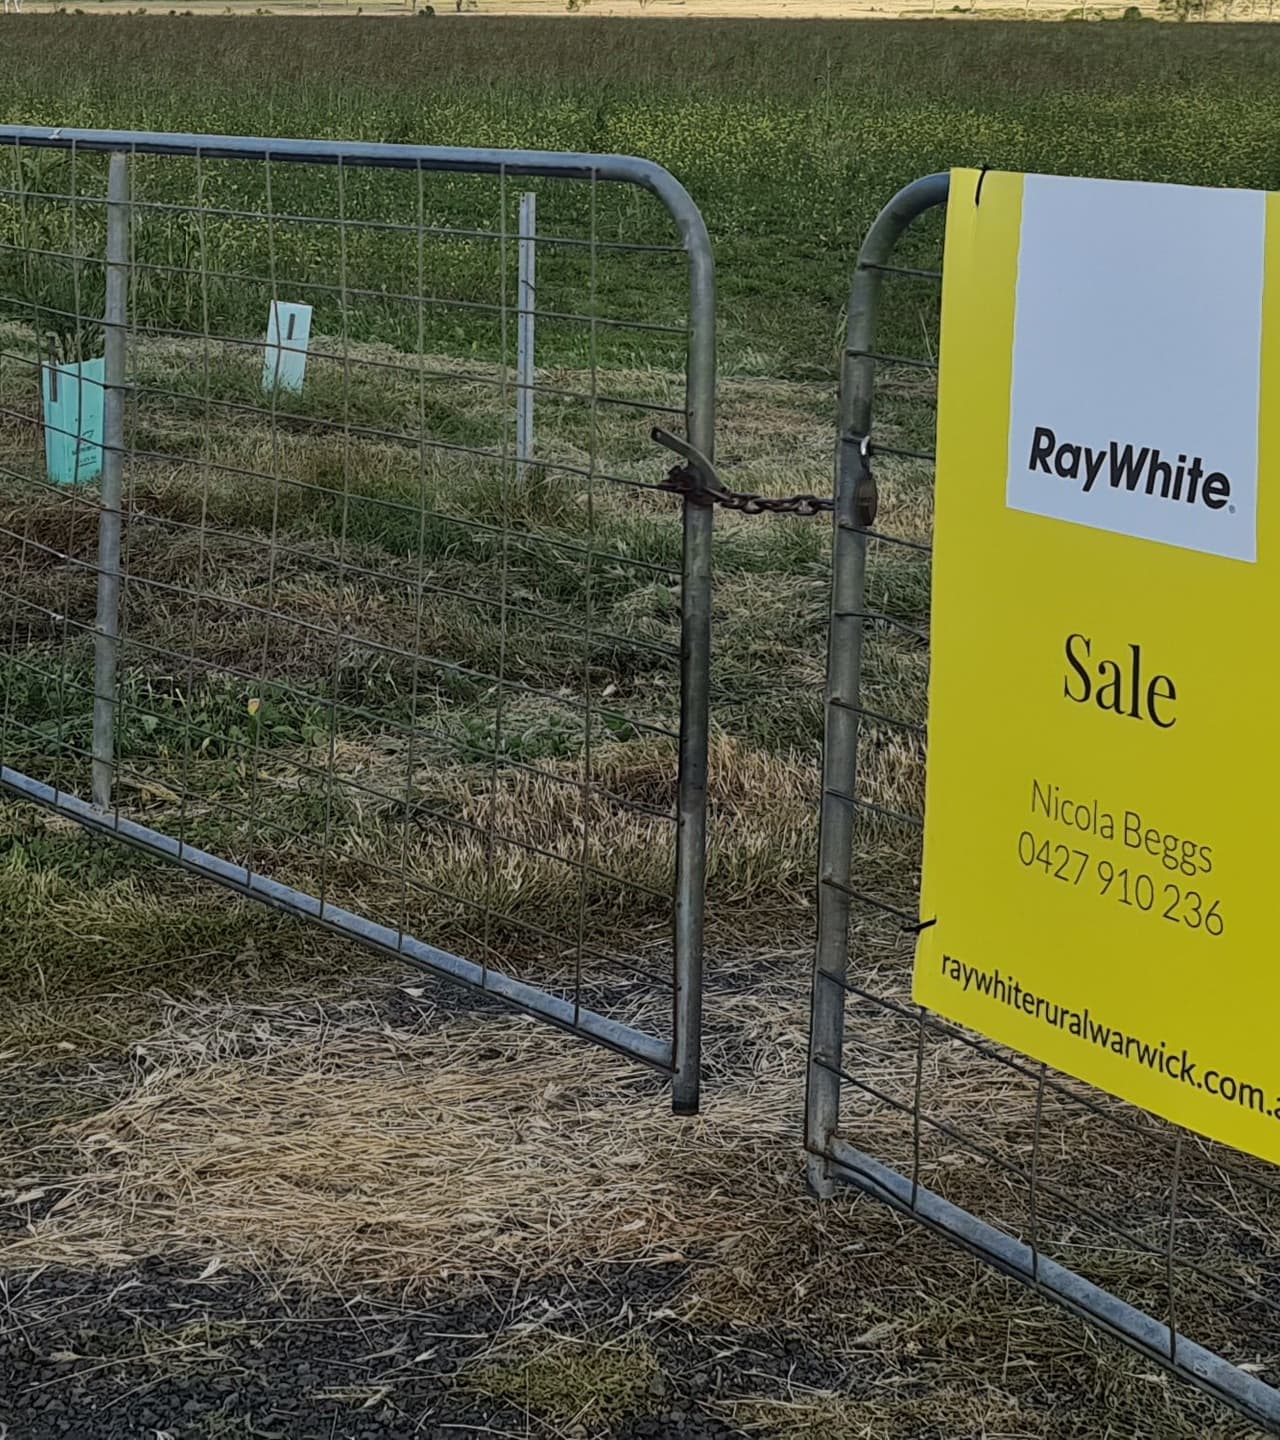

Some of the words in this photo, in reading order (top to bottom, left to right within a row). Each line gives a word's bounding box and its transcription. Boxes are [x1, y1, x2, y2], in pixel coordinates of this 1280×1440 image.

[1063, 633, 1177, 729] Sale
[1031, 778, 1115, 841] Nicola
[1123, 810, 1213, 877] Beggs
[1018, 830, 1090, 886] 0427
[1097, 860, 1155, 912] 910
[1162, 883, 1225, 937] 236
